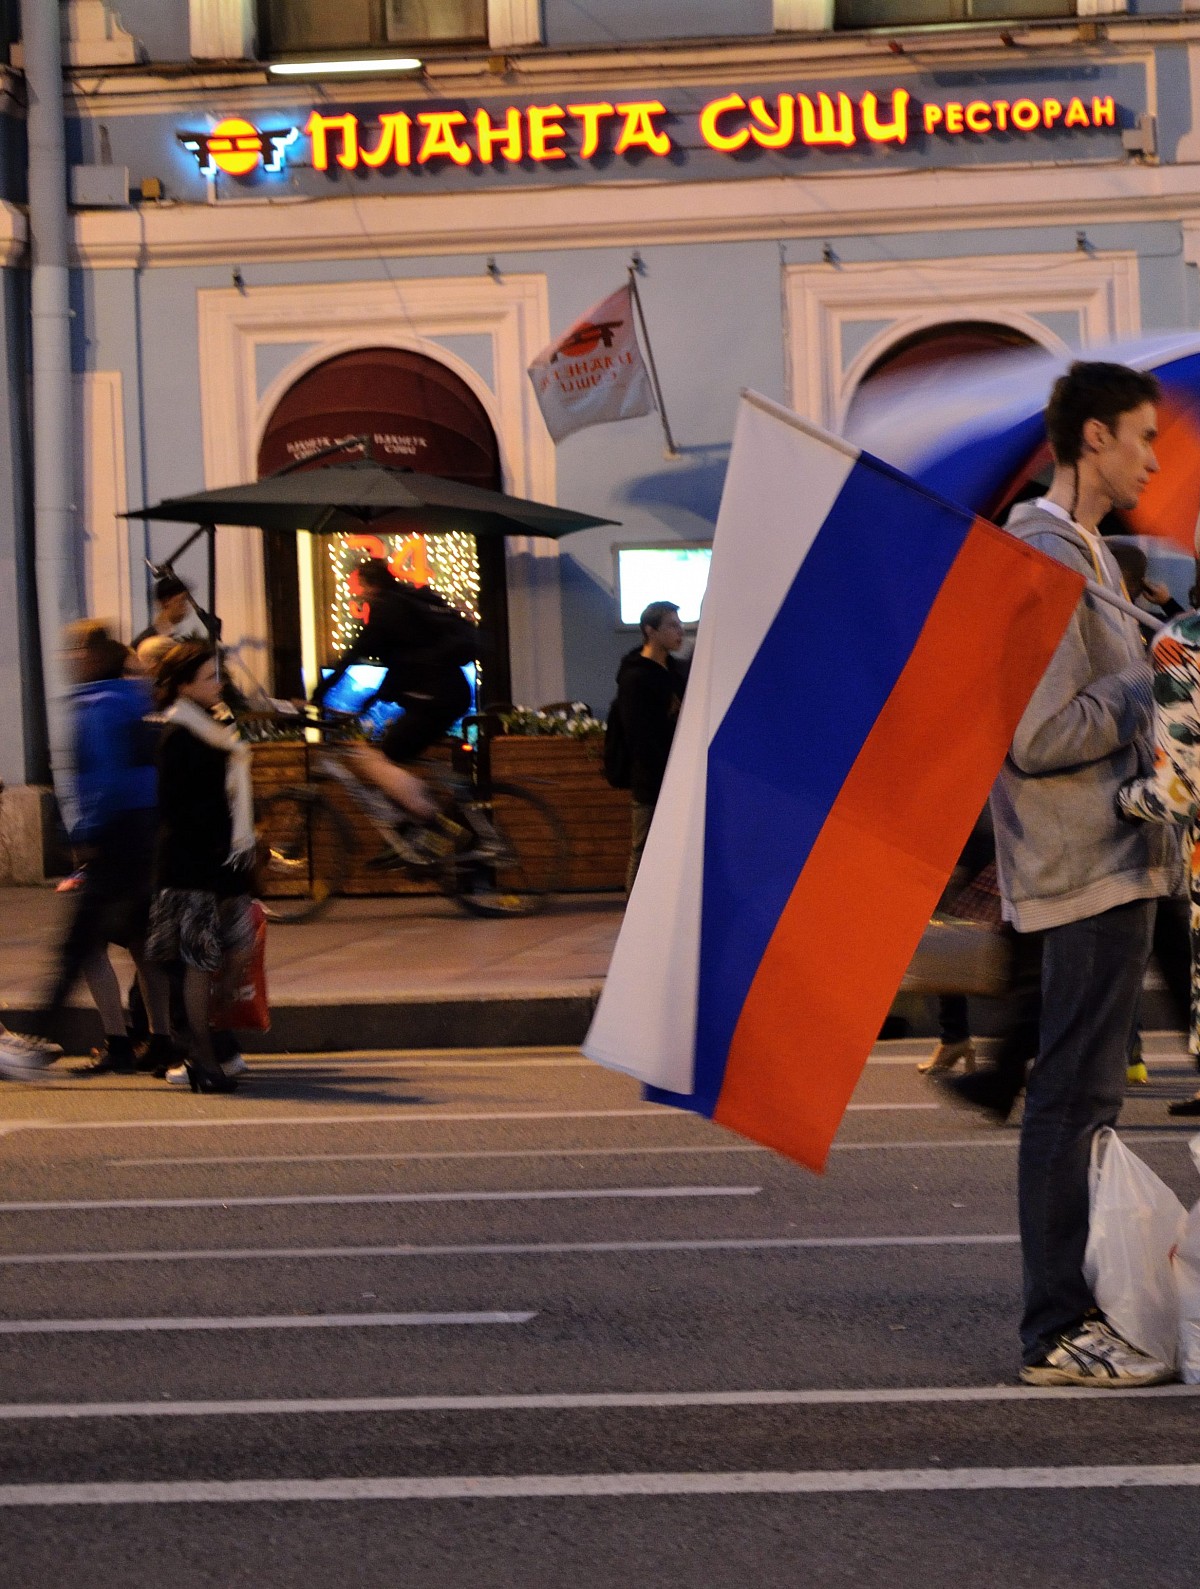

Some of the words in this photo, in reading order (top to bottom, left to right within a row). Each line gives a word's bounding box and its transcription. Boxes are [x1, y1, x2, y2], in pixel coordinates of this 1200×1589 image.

[306, 99, 672, 171] ПЛАНЕТА
[699, 88, 910, 152] СУШИ
[922, 95, 1115, 134] РЕСТОРАН
